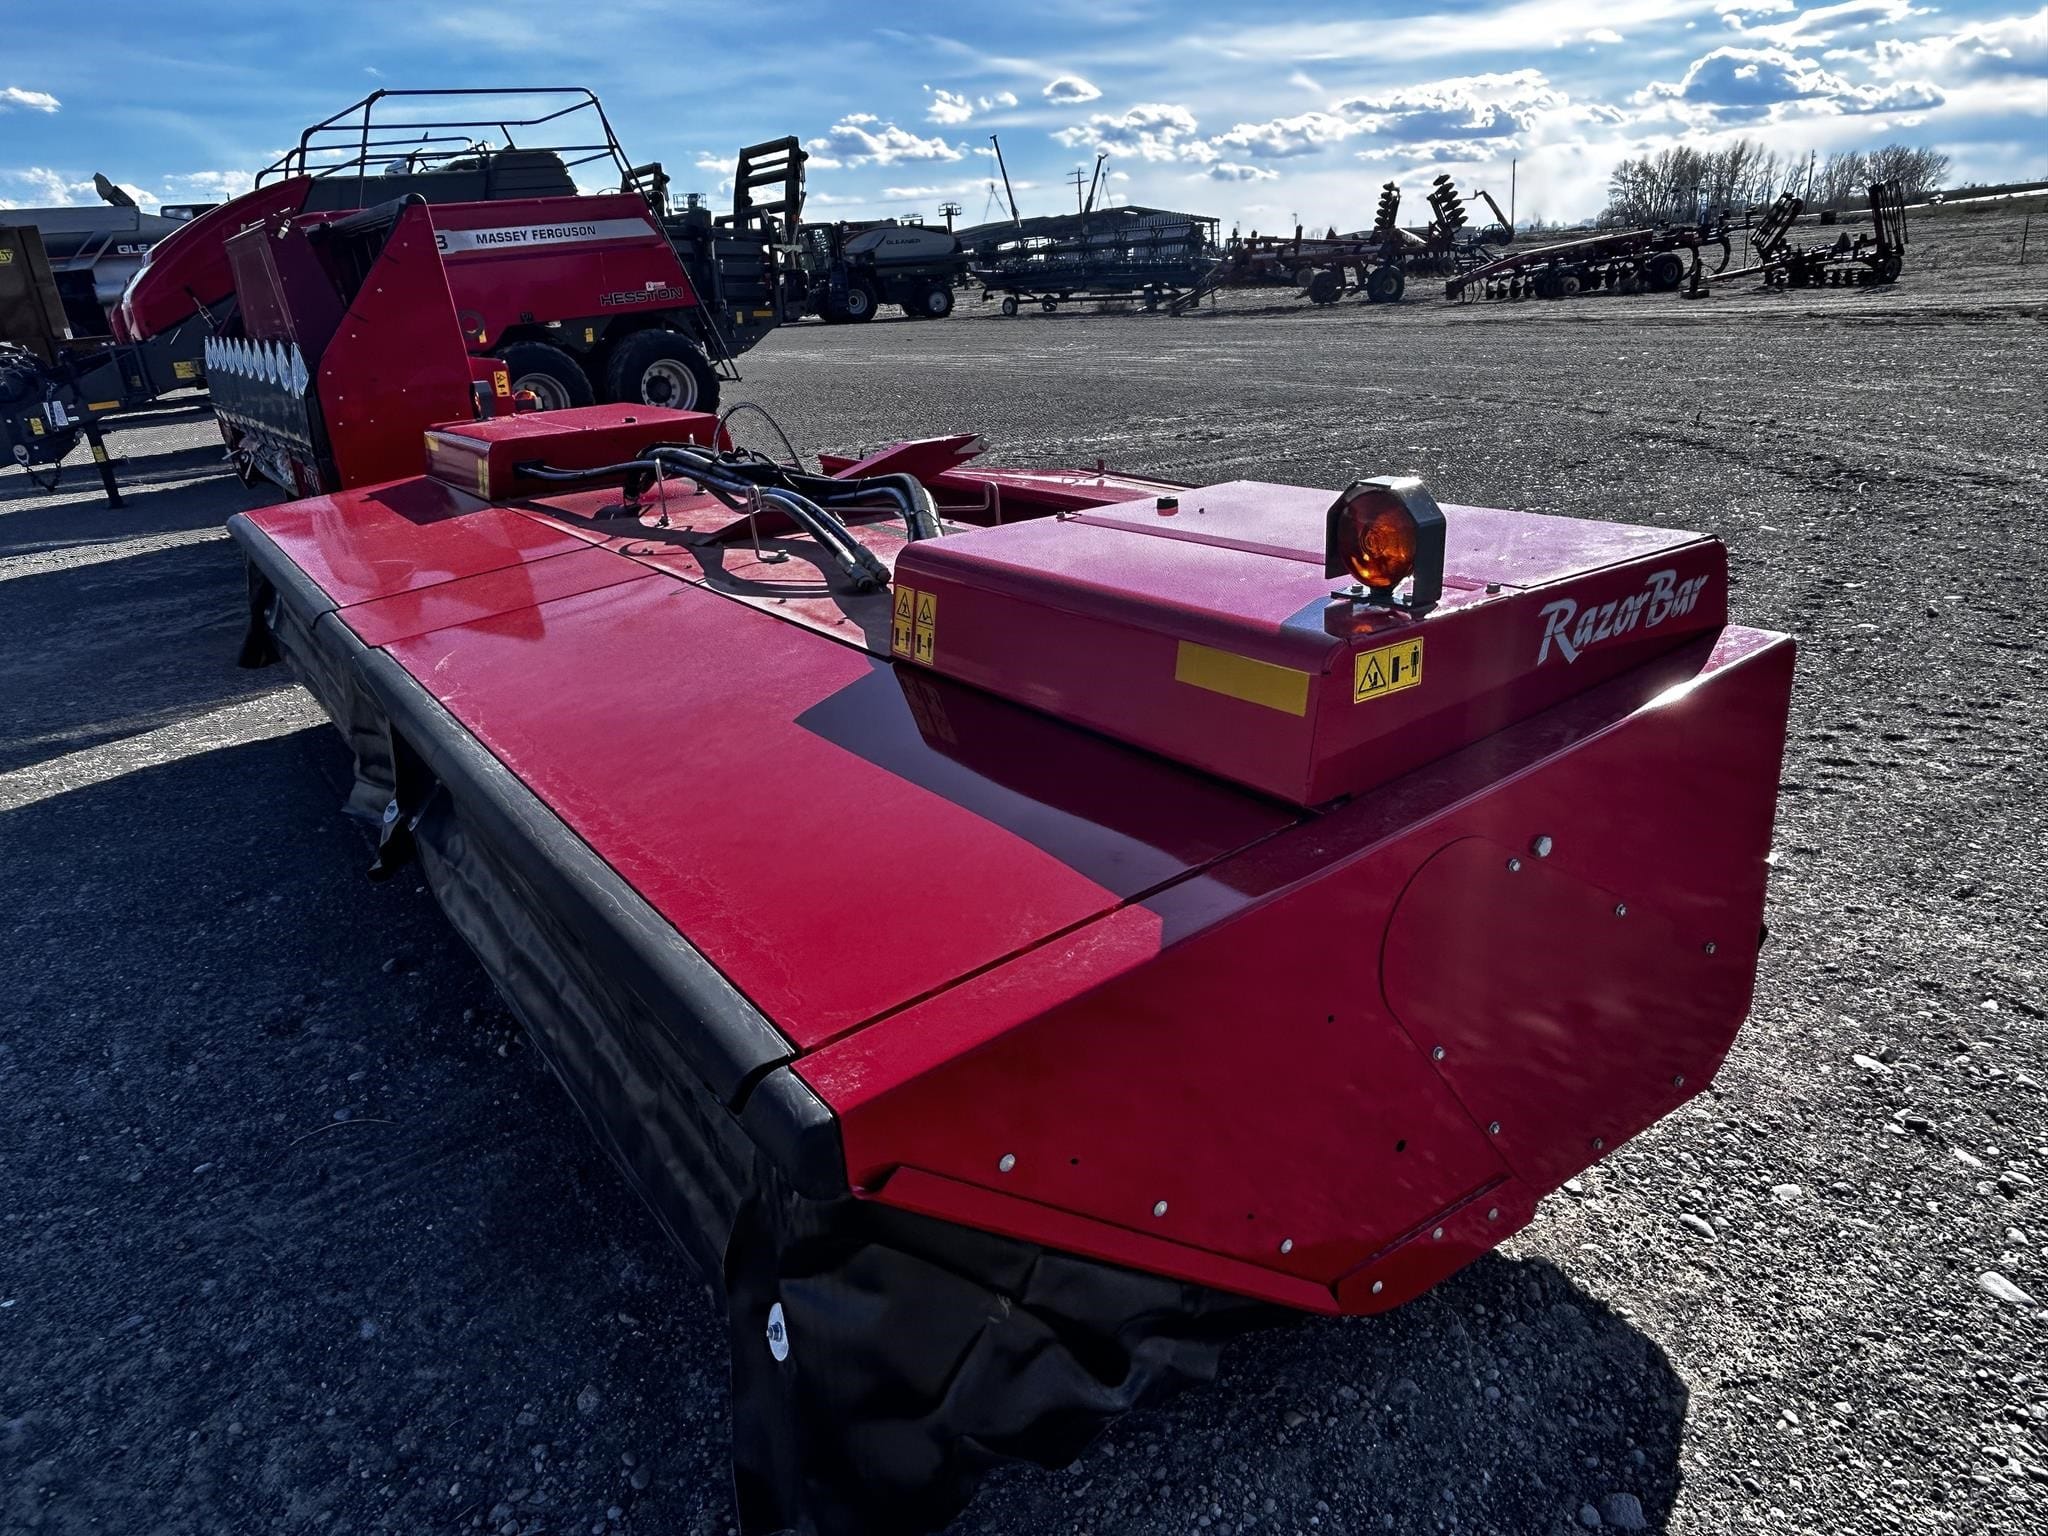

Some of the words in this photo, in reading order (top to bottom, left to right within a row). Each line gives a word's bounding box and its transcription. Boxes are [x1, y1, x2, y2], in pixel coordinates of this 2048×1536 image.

[476, 230, 527, 244] MASSEY
[532, 225, 596, 240] FERGUSON
[117, 244, 153, 254] GLE
[600, 287, 684, 306] HESSTON
